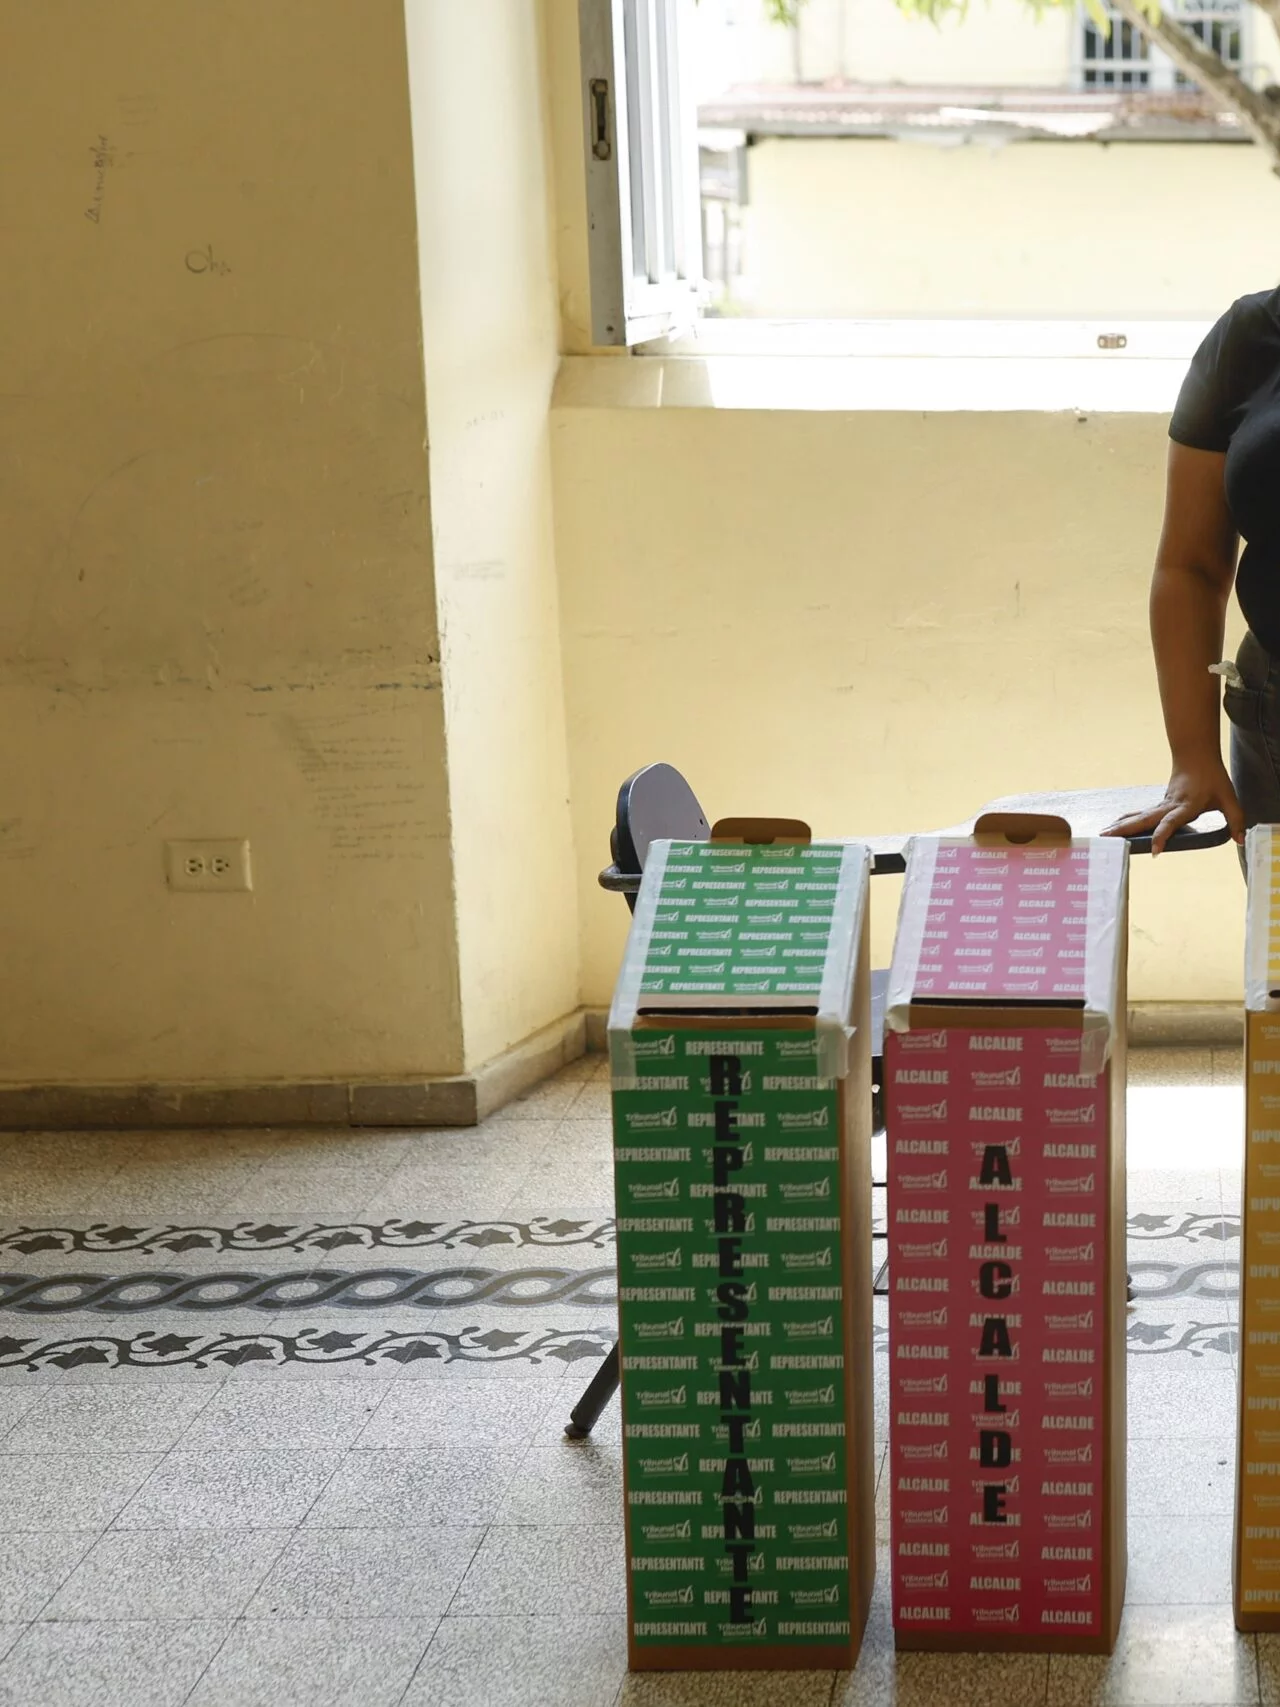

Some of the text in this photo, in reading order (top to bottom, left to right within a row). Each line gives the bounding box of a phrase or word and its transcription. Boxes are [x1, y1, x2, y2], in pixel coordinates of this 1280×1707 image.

[685, 1041, 764, 1055] REPRESENTANTE
[969, 1036, 1023, 1051] ALCALDE
[895, 1069, 949, 1084] ALCALDE
[969, 1106, 1023, 1121] ALCALDE
[896, 1140, 949, 1154] ALCALDE
[1043, 1143, 1096, 1158] ALCALDE
[896, 1209, 949, 1224] ALCALDE
[1043, 1212, 1096, 1227] ALCALDE
[969, 1245, 1022, 1260] ALCALDE
[897, 1277, 949, 1292] ALCALDE
[1042, 1281, 1095, 1296] ALCALDE
[709, 1055, 755, 1624] REPRESENTANTE
[979, 1145, 1013, 1522] ALCALDE
[898, 1345, 949, 1359] ALCALDE
[1042, 1348, 1094, 1363] ALCALDE
[899, 1412, 949, 1426] ALCALDE
[1042, 1415, 1093, 1430] ALCALDE
[899, 1478, 949, 1492] ALCALDE
[1041, 1481, 1093, 1496] ALCALDE
[900, 1543, 950, 1556] ALCALDE
[1041, 1546, 1092, 1560] ALCALDE
[970, 1577, 1021, 1590] ALCALDE
[900, 1607, 950, 1620] ALCALDE
[1041, 1610, 1092, 1624] ALCALDE
